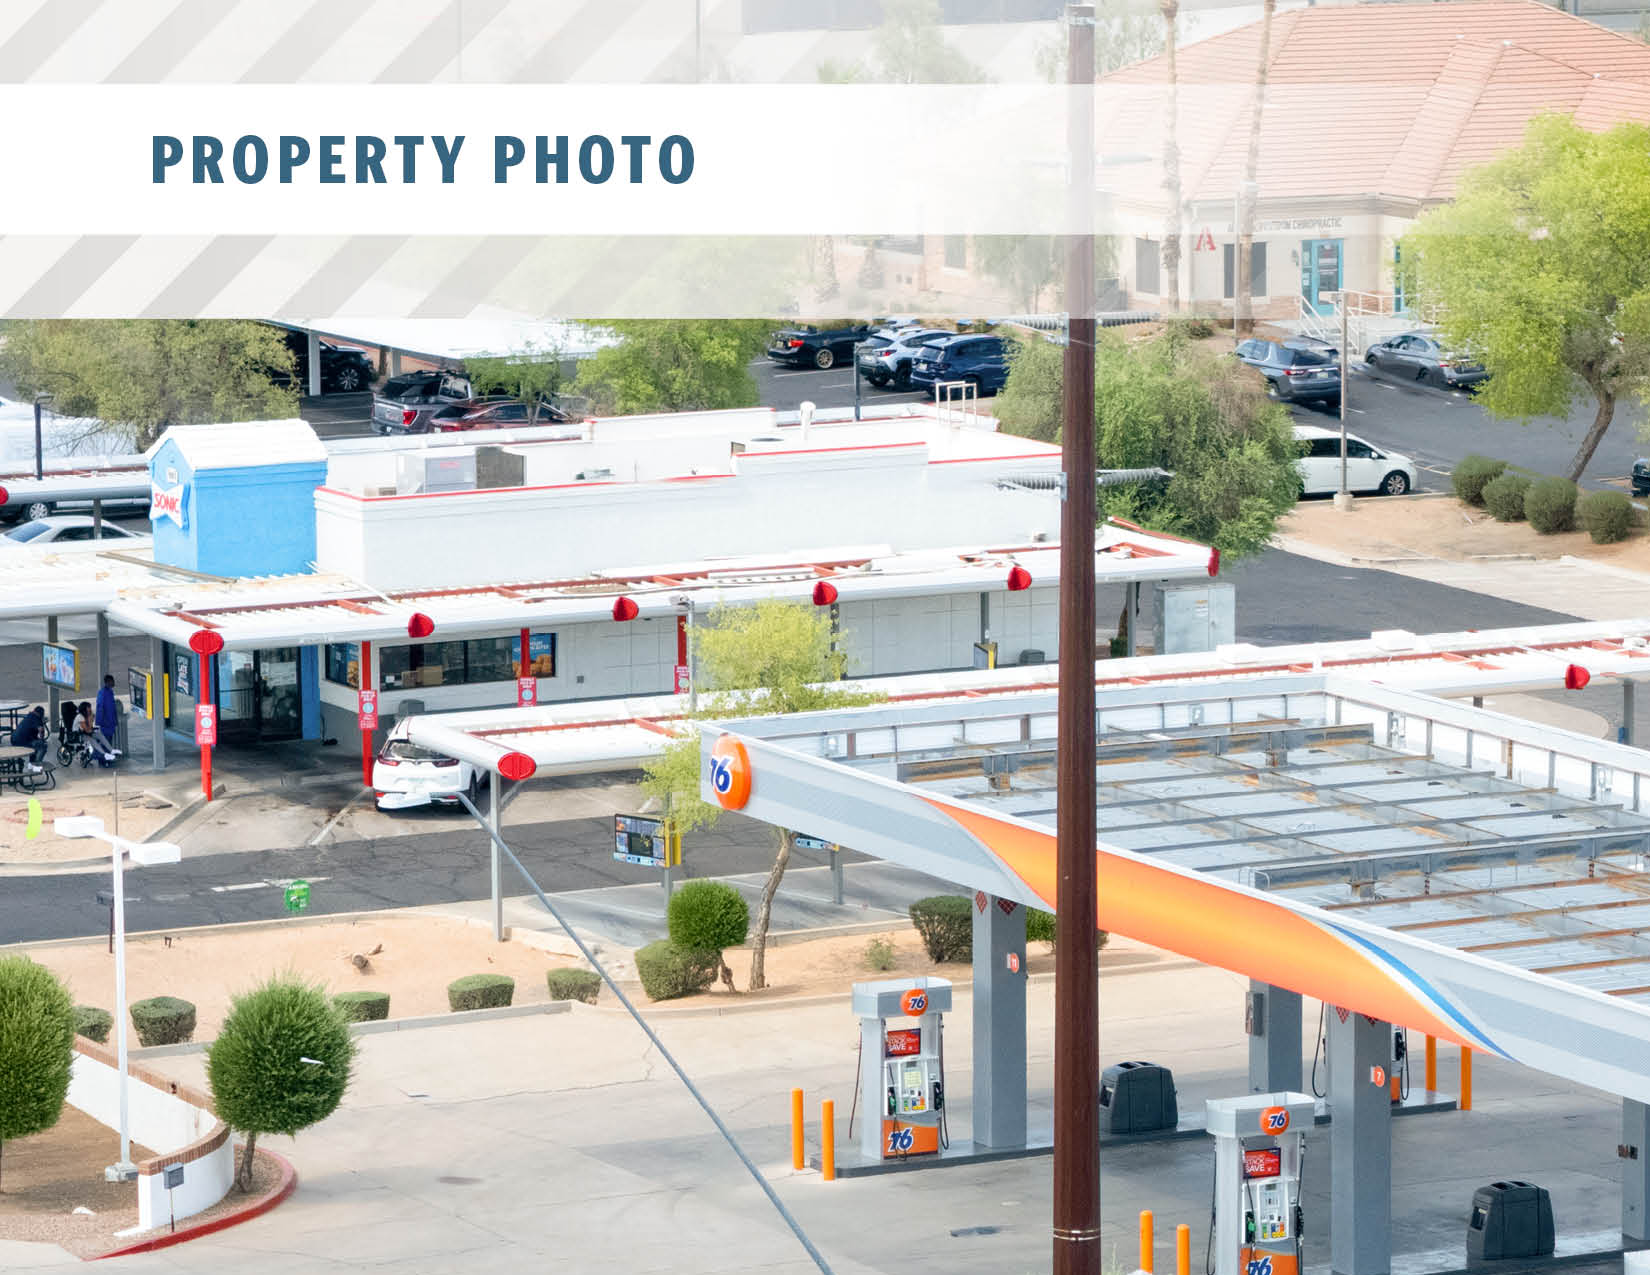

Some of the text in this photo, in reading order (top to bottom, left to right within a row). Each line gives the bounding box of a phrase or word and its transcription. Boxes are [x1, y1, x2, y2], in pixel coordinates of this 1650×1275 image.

[154, 492, 180, 513] SONIC
[908, 996, 927, 1011] 76
[1268, 1112, 1286, 1129] 76
[887, 1128, 913, 1153] 76
